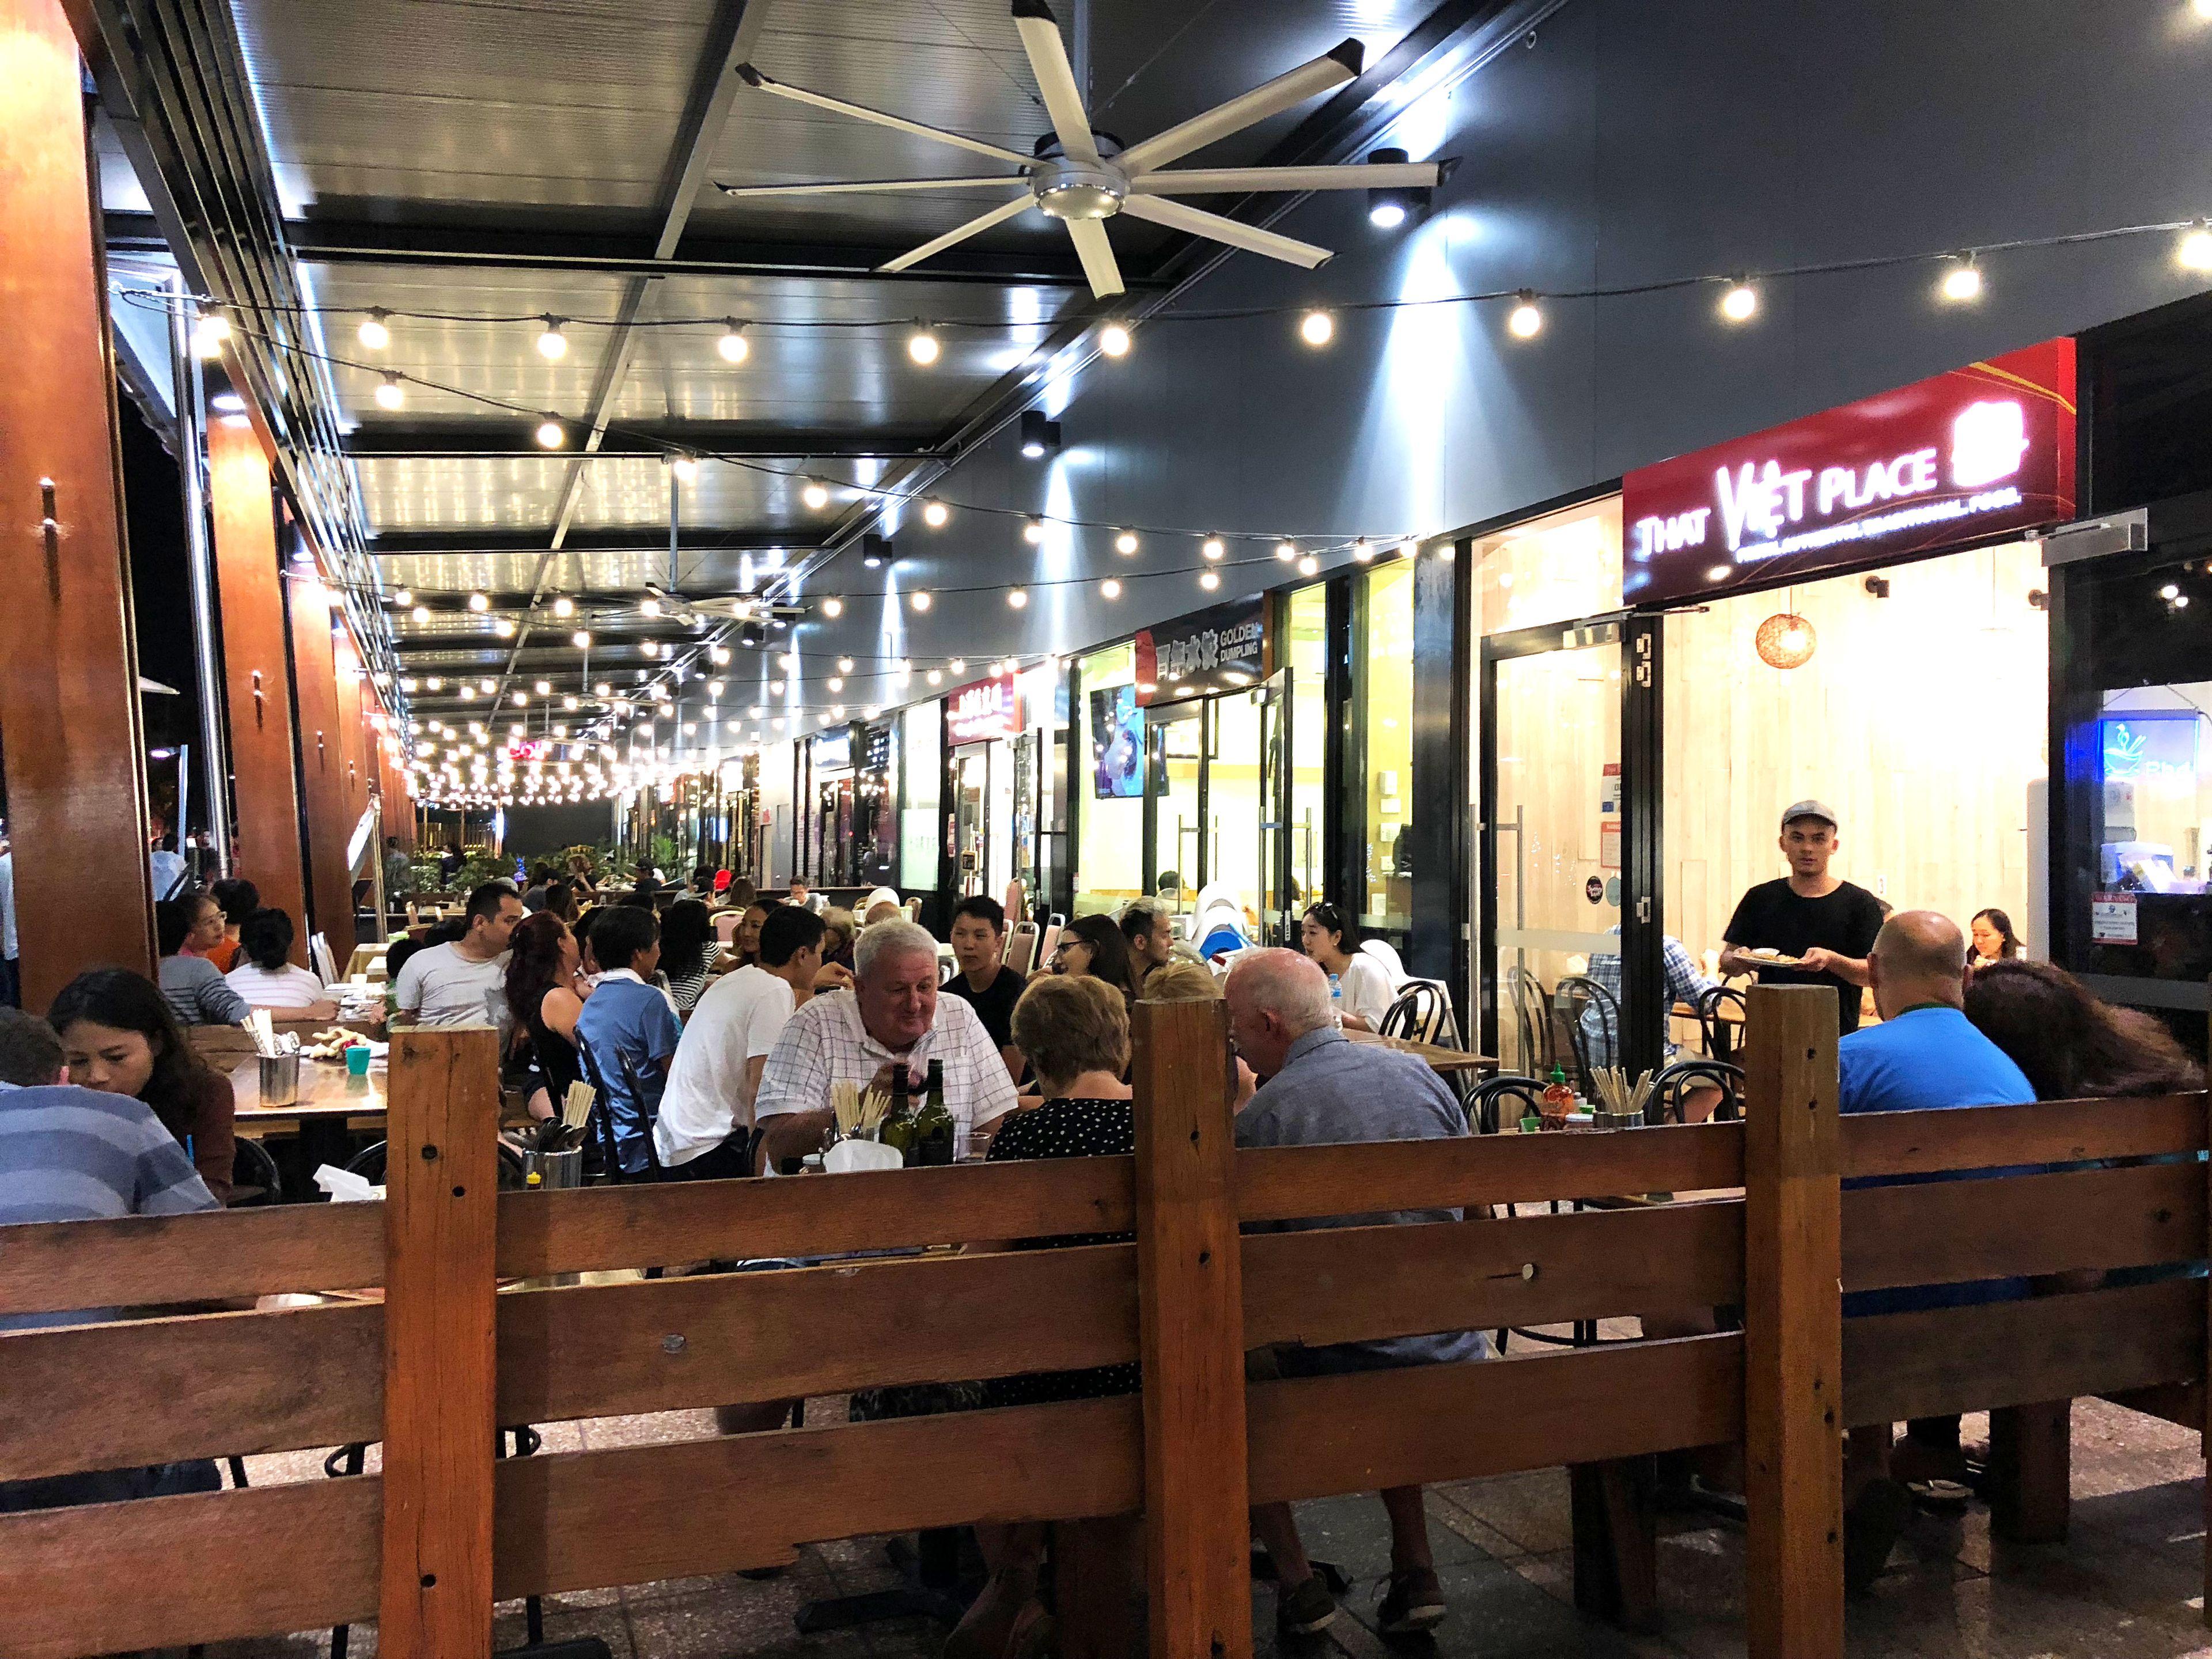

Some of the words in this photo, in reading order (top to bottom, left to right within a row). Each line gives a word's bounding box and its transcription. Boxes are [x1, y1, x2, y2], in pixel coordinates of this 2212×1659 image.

[1637, 507, 1711, 556] THAT
[1820, 447, 1938, 513] PLACE
[1220, 622, 1263, 647] GOLDEN
[1221, 641, 1258, 662] DUMPLING
